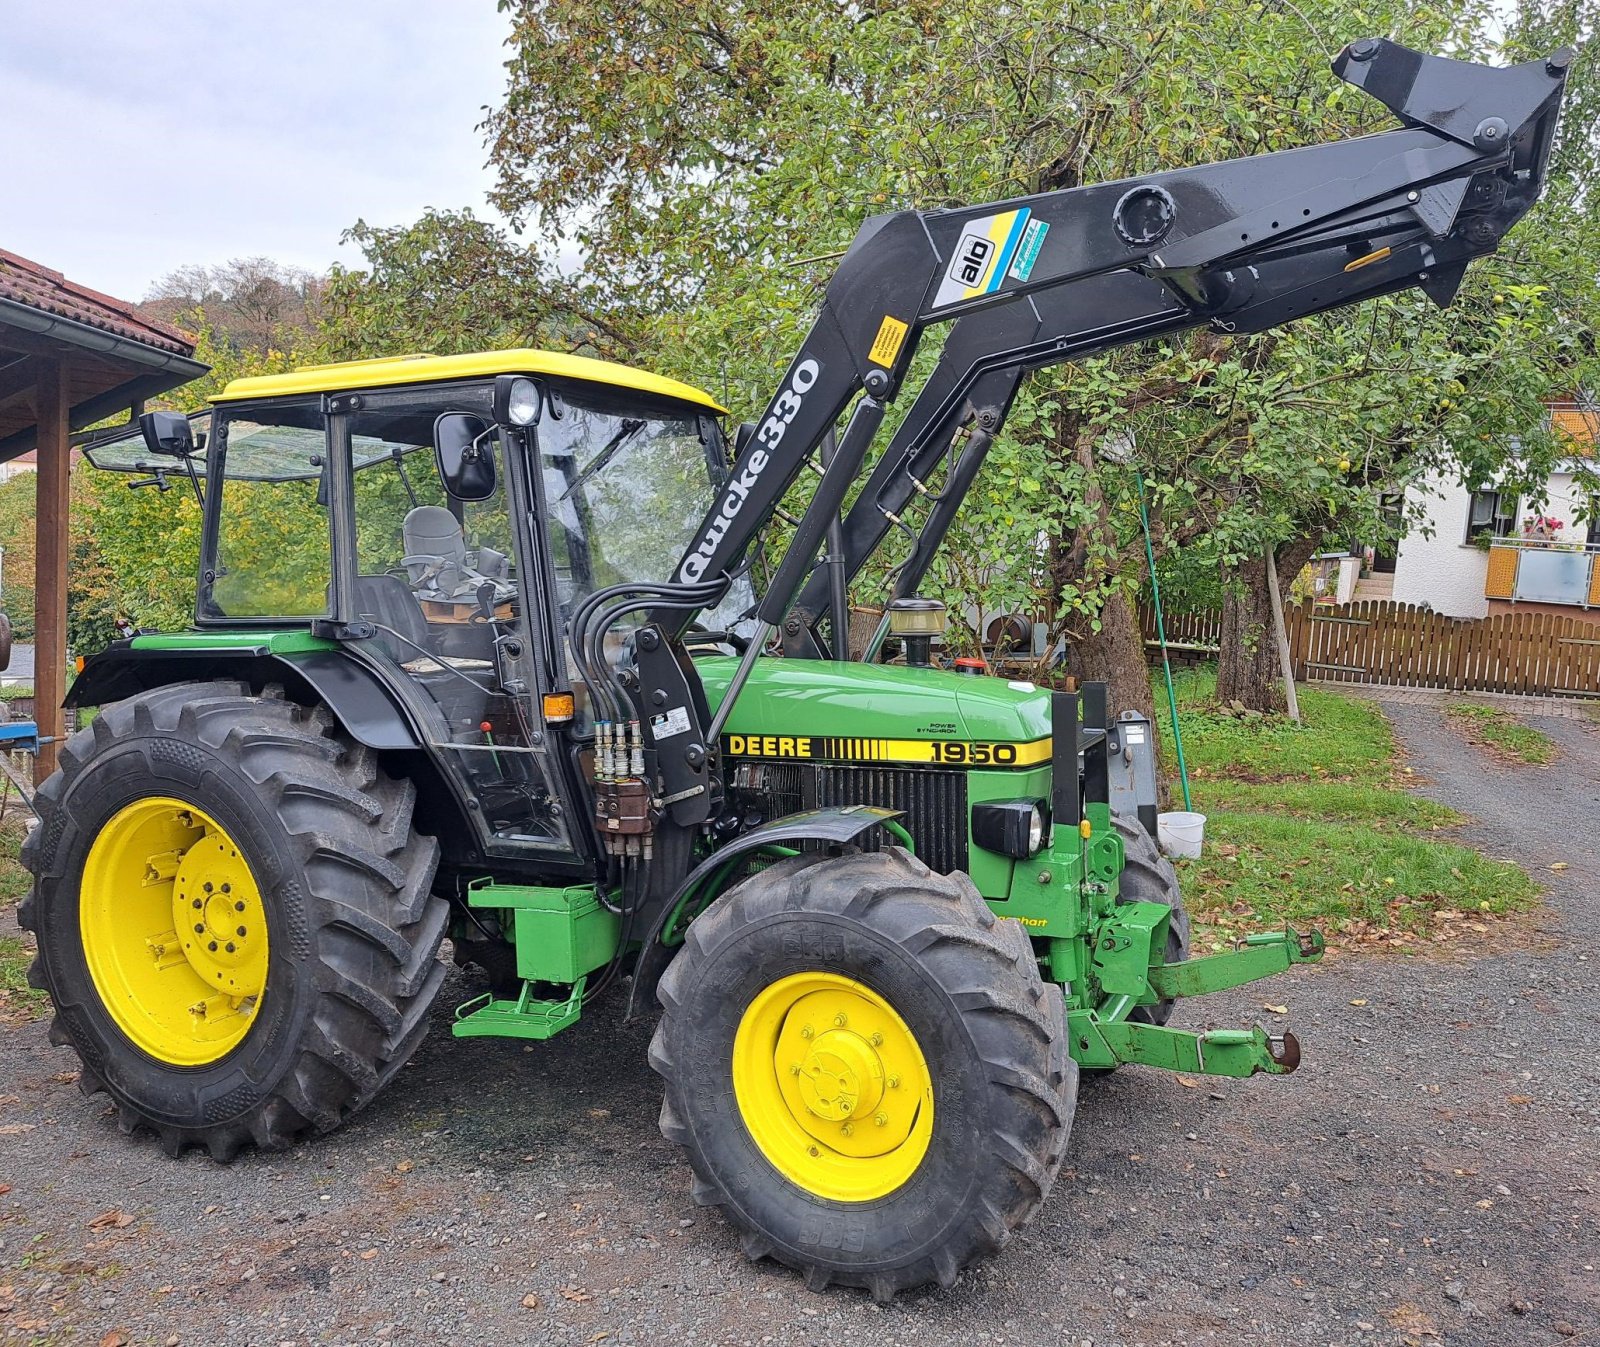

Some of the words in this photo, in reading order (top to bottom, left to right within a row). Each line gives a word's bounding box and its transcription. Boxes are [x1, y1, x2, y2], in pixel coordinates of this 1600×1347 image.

[680, 449, 770, 585] Quicke
[757, 359, 820, 451] 330
[729, 736, 811, 758] DEERE
[931, 742, 1017, 764] 1950
